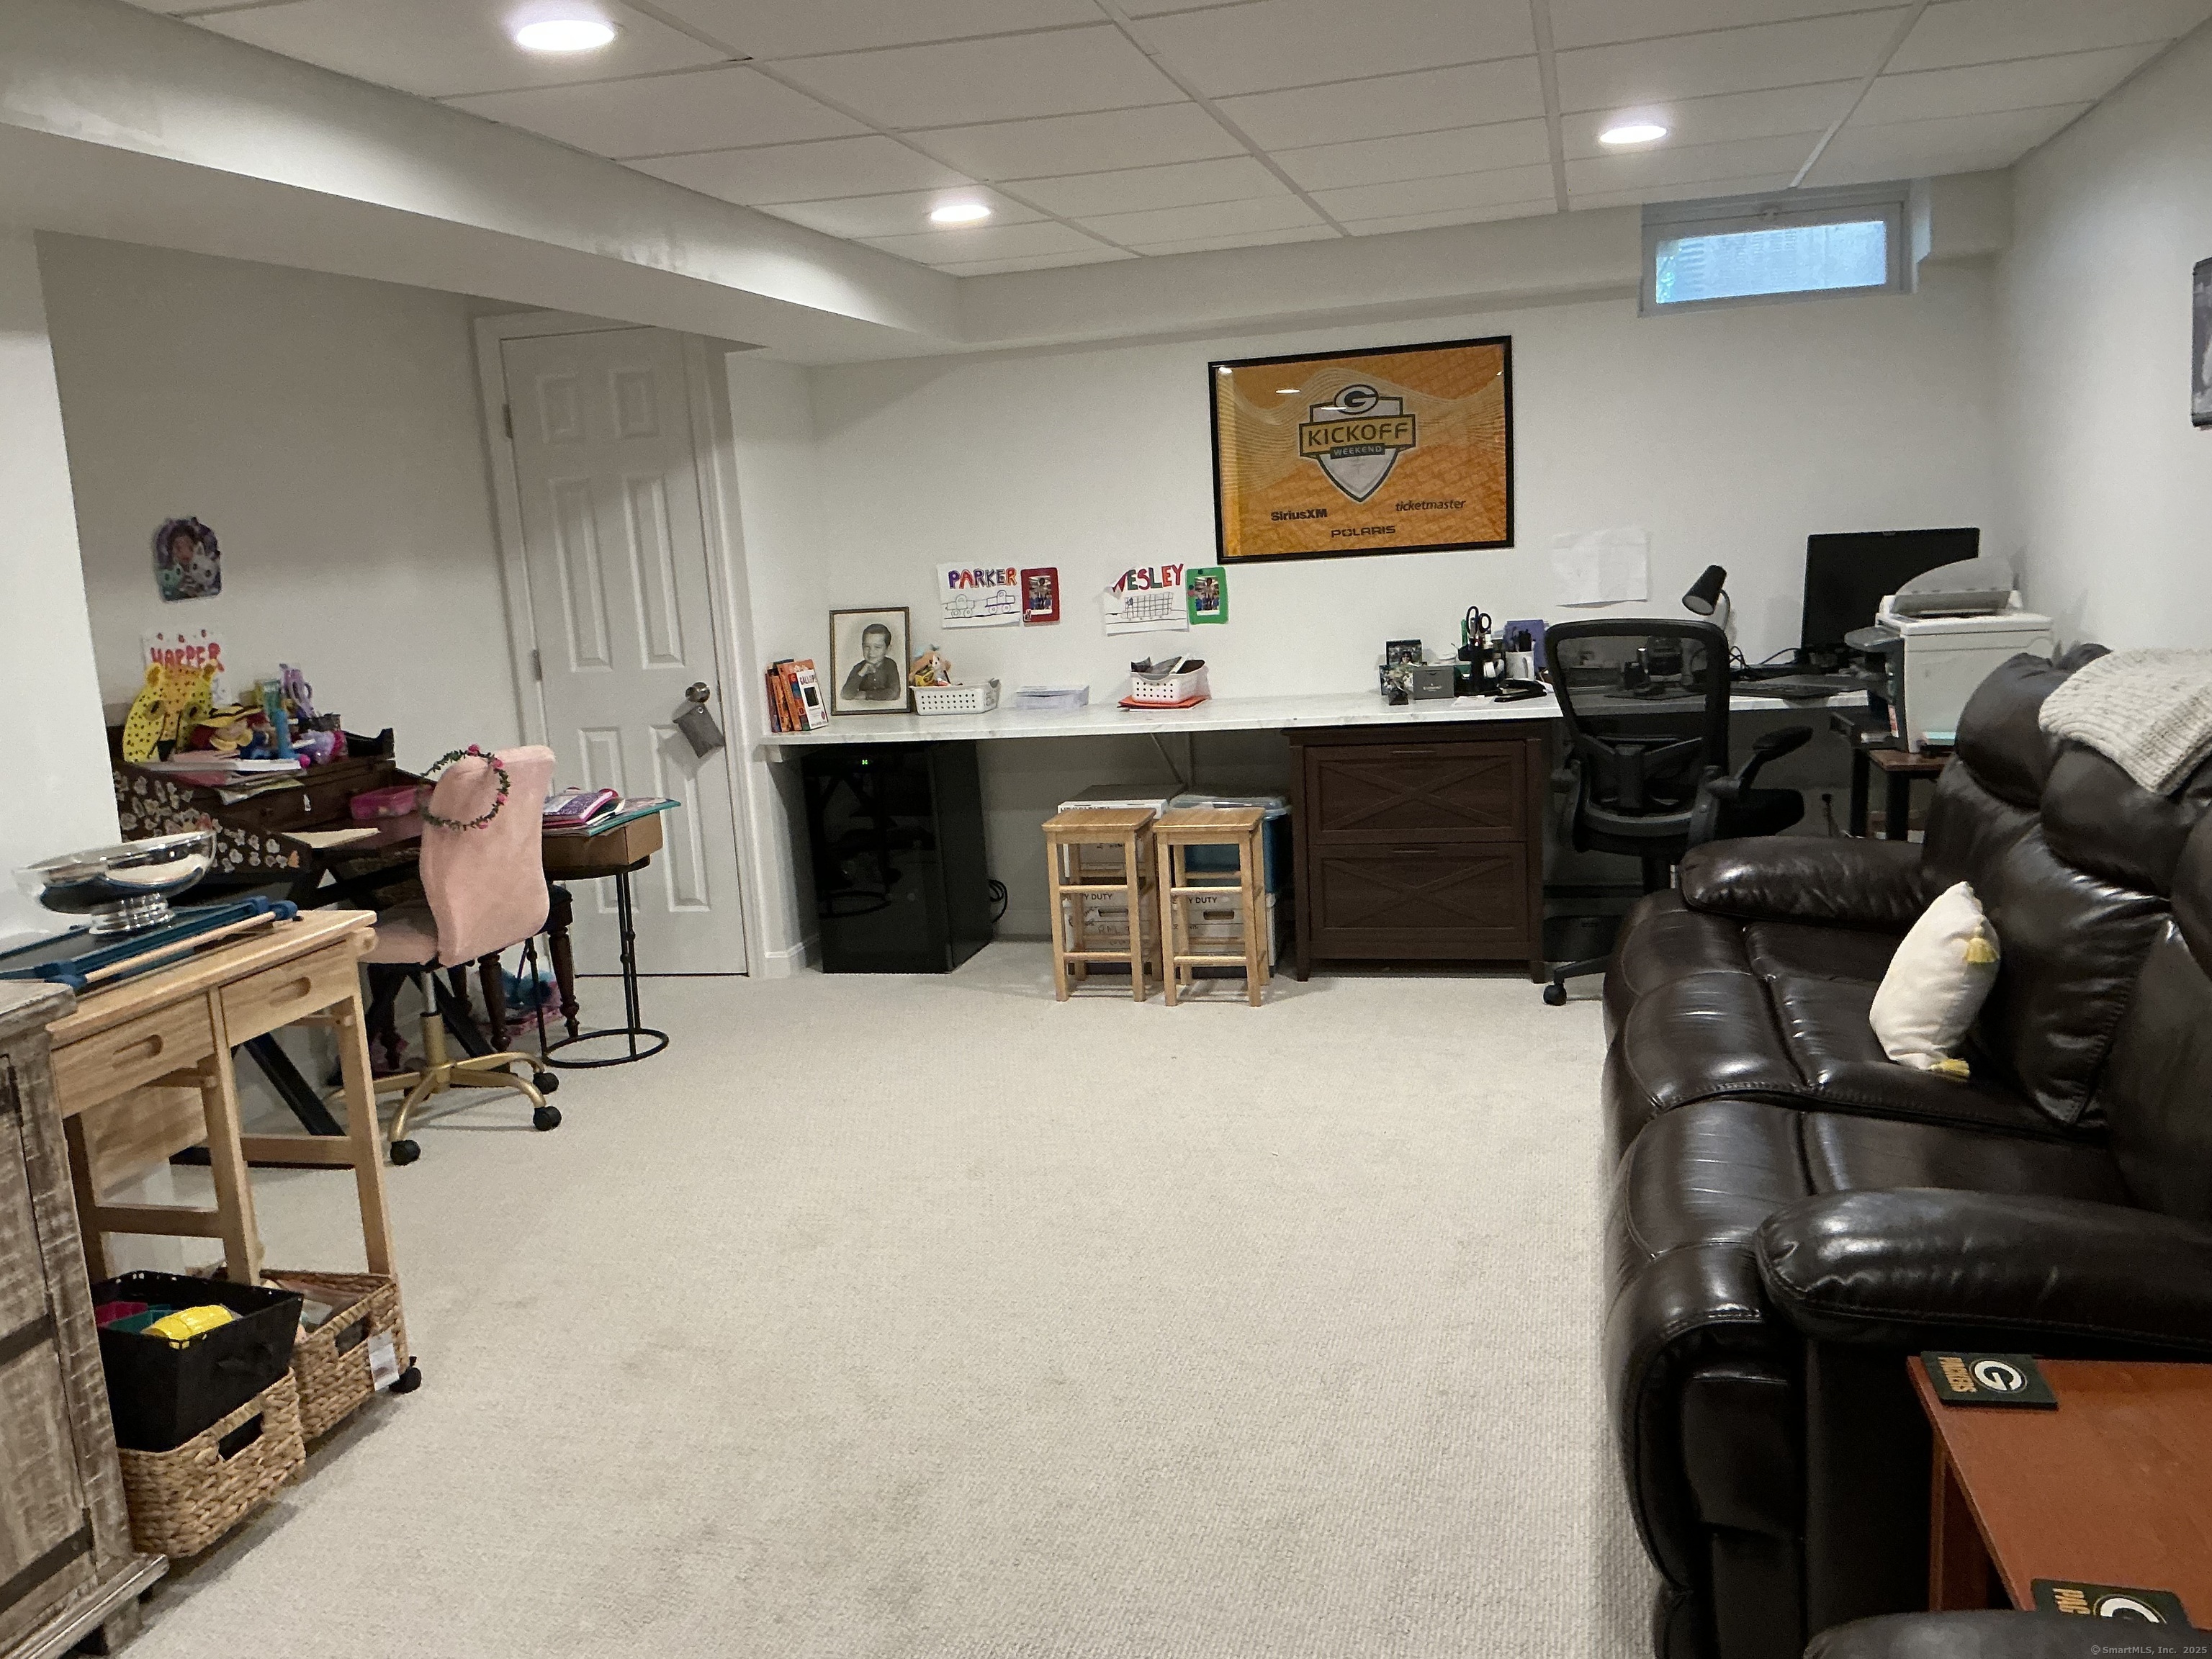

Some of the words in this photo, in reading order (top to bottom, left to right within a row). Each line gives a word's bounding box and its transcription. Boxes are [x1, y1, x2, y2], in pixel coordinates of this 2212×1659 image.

[1308, 422, 1408, 446] KICKOFF
[1334, 445, 1382, 456] WEEKEND
[1395, 498, 1466, 512] ticketmaster
[1270, 508, 1328, 521] SiriusXM
[1331, 525, 1396, 538] POLARIS
[948, 567, 1018, 590] PARKER
